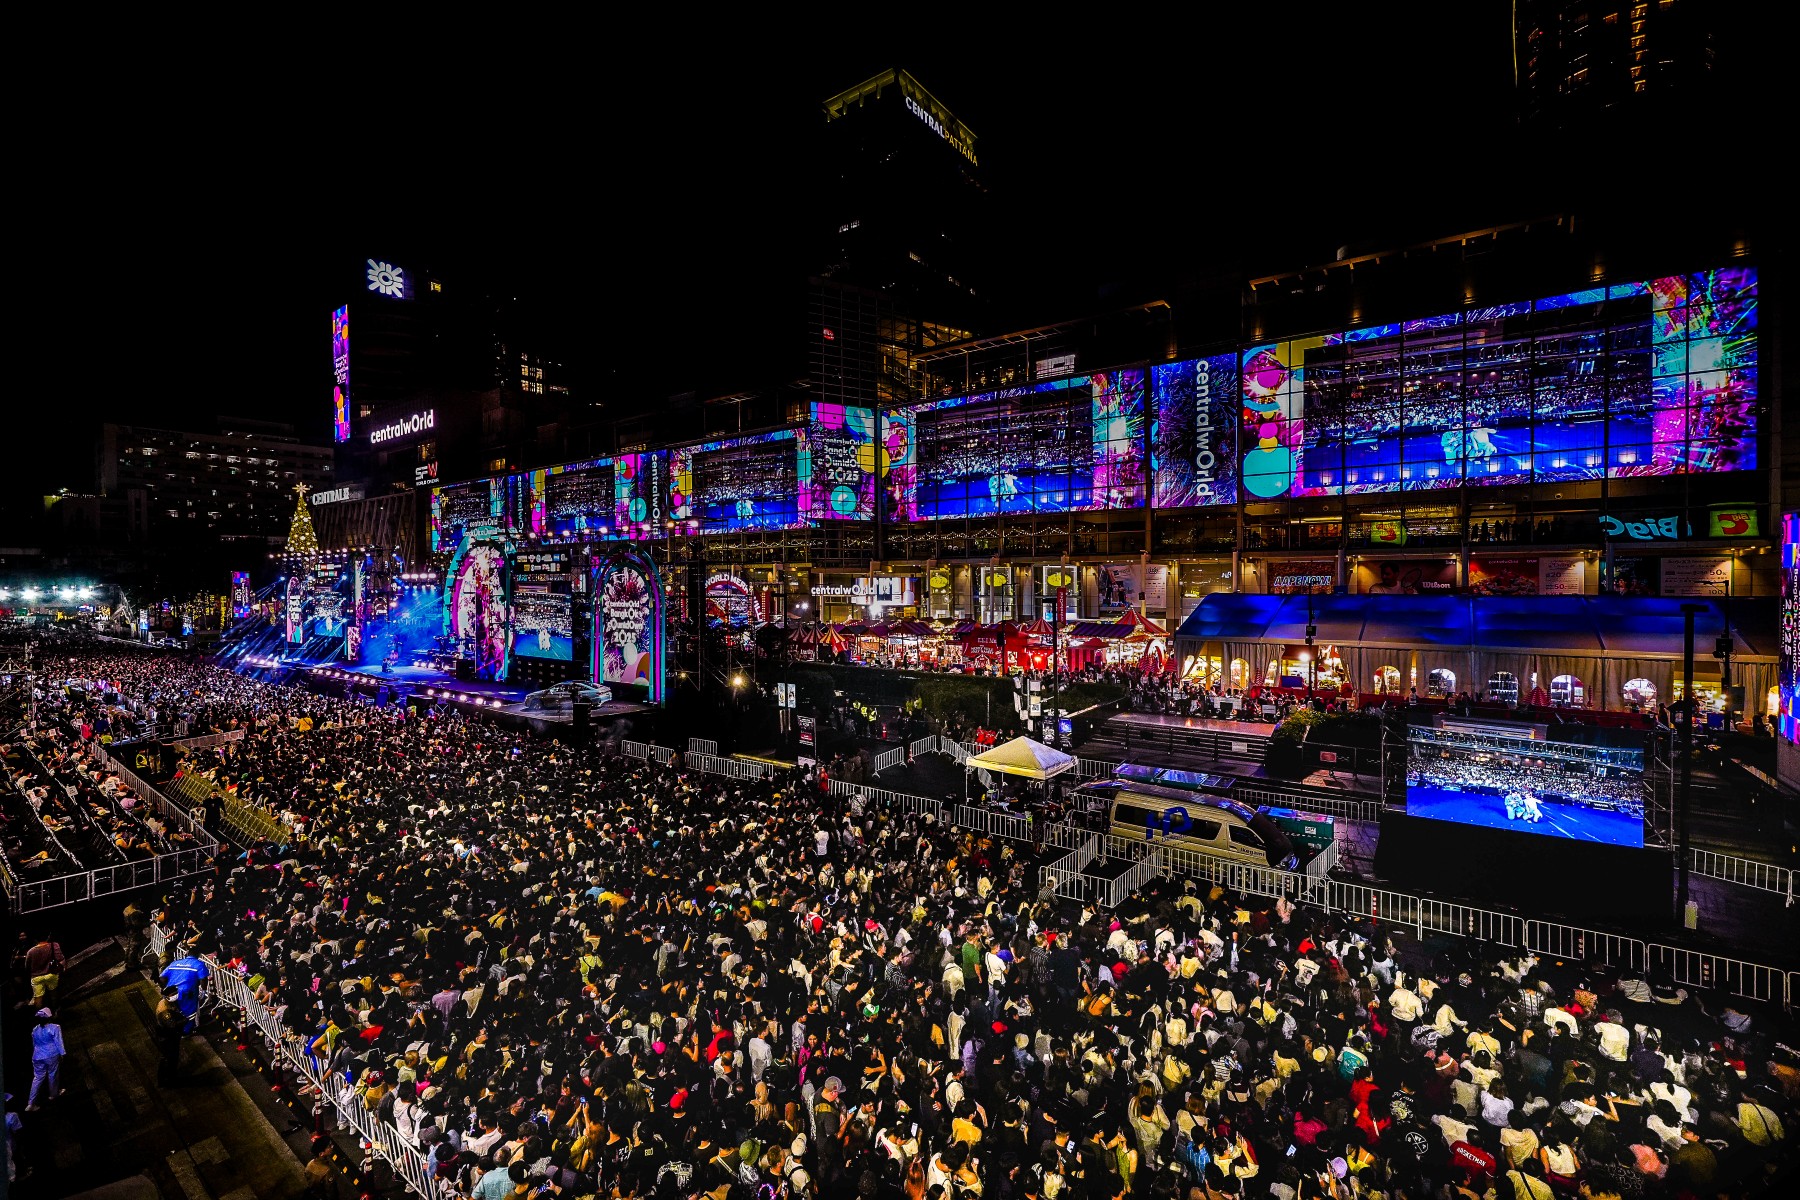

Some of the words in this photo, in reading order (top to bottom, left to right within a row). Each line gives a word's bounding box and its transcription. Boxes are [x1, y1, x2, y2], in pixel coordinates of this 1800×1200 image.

[371, 409, 434, 444] centralwOrld
[1196, 360, 1215, 496] centralwOrld
[651, 453, 661, 535] centralwOrld
[828, 467, 859, 483] 2025
[517, 475, 525, 533] centralwOr
[811, 584, 875, 595] centralwOrld
[613, 629, 637, 646] 2025
[1784, 599, 1793, 655] 2025
